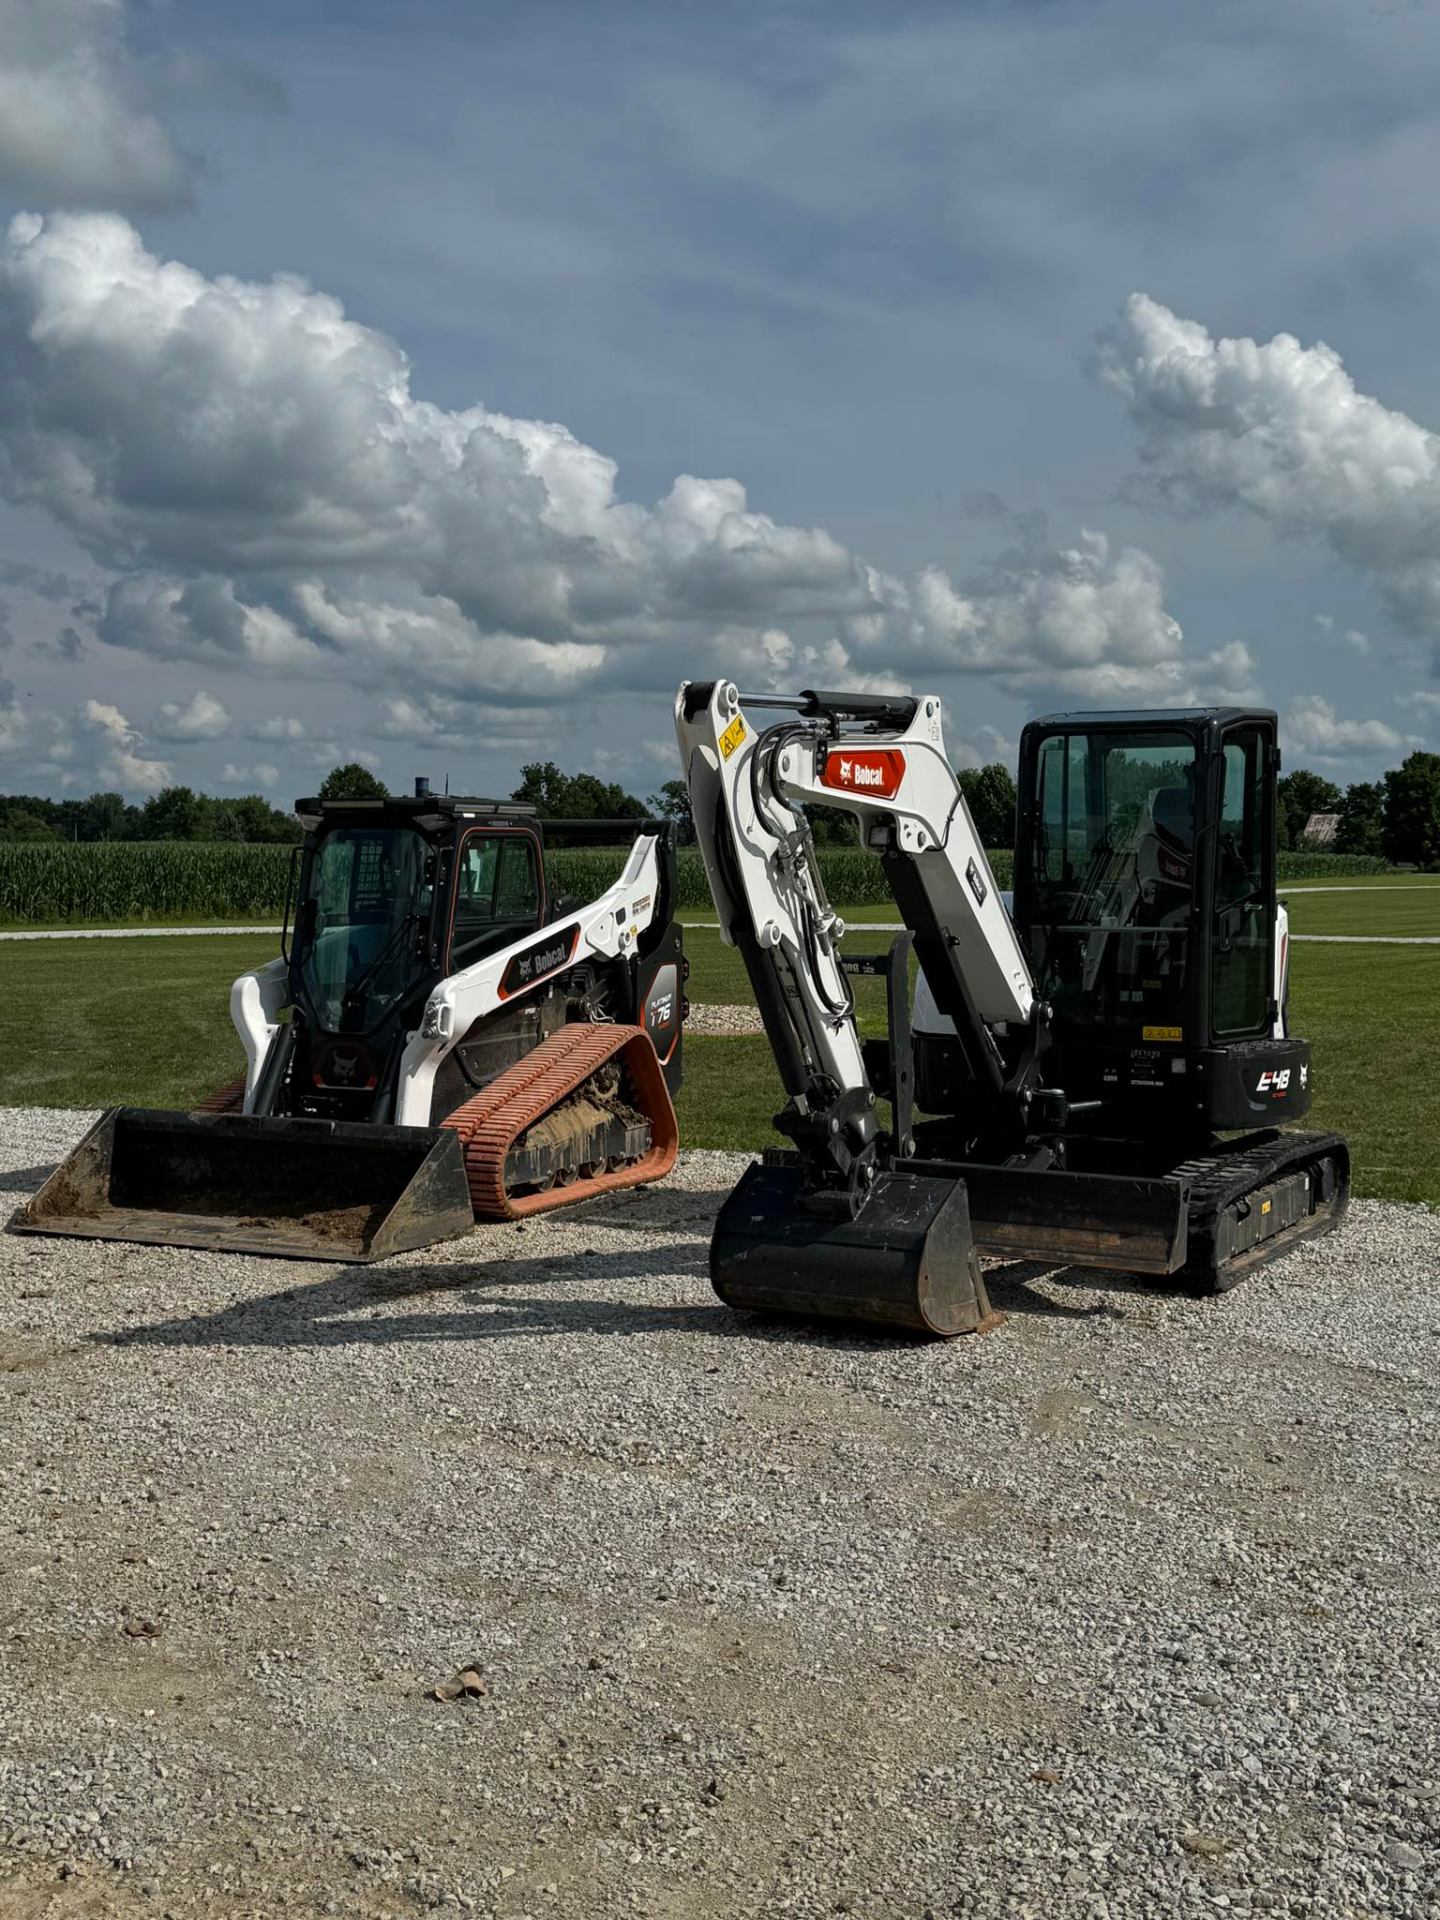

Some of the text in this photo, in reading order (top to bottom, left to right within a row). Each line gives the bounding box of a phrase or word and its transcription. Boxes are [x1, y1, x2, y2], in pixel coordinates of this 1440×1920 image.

[854, 764, 883, 786] Bobcat
[535, 943, 566, 974] Bobcat
[1256, 1069, 1291, 1092] E48
